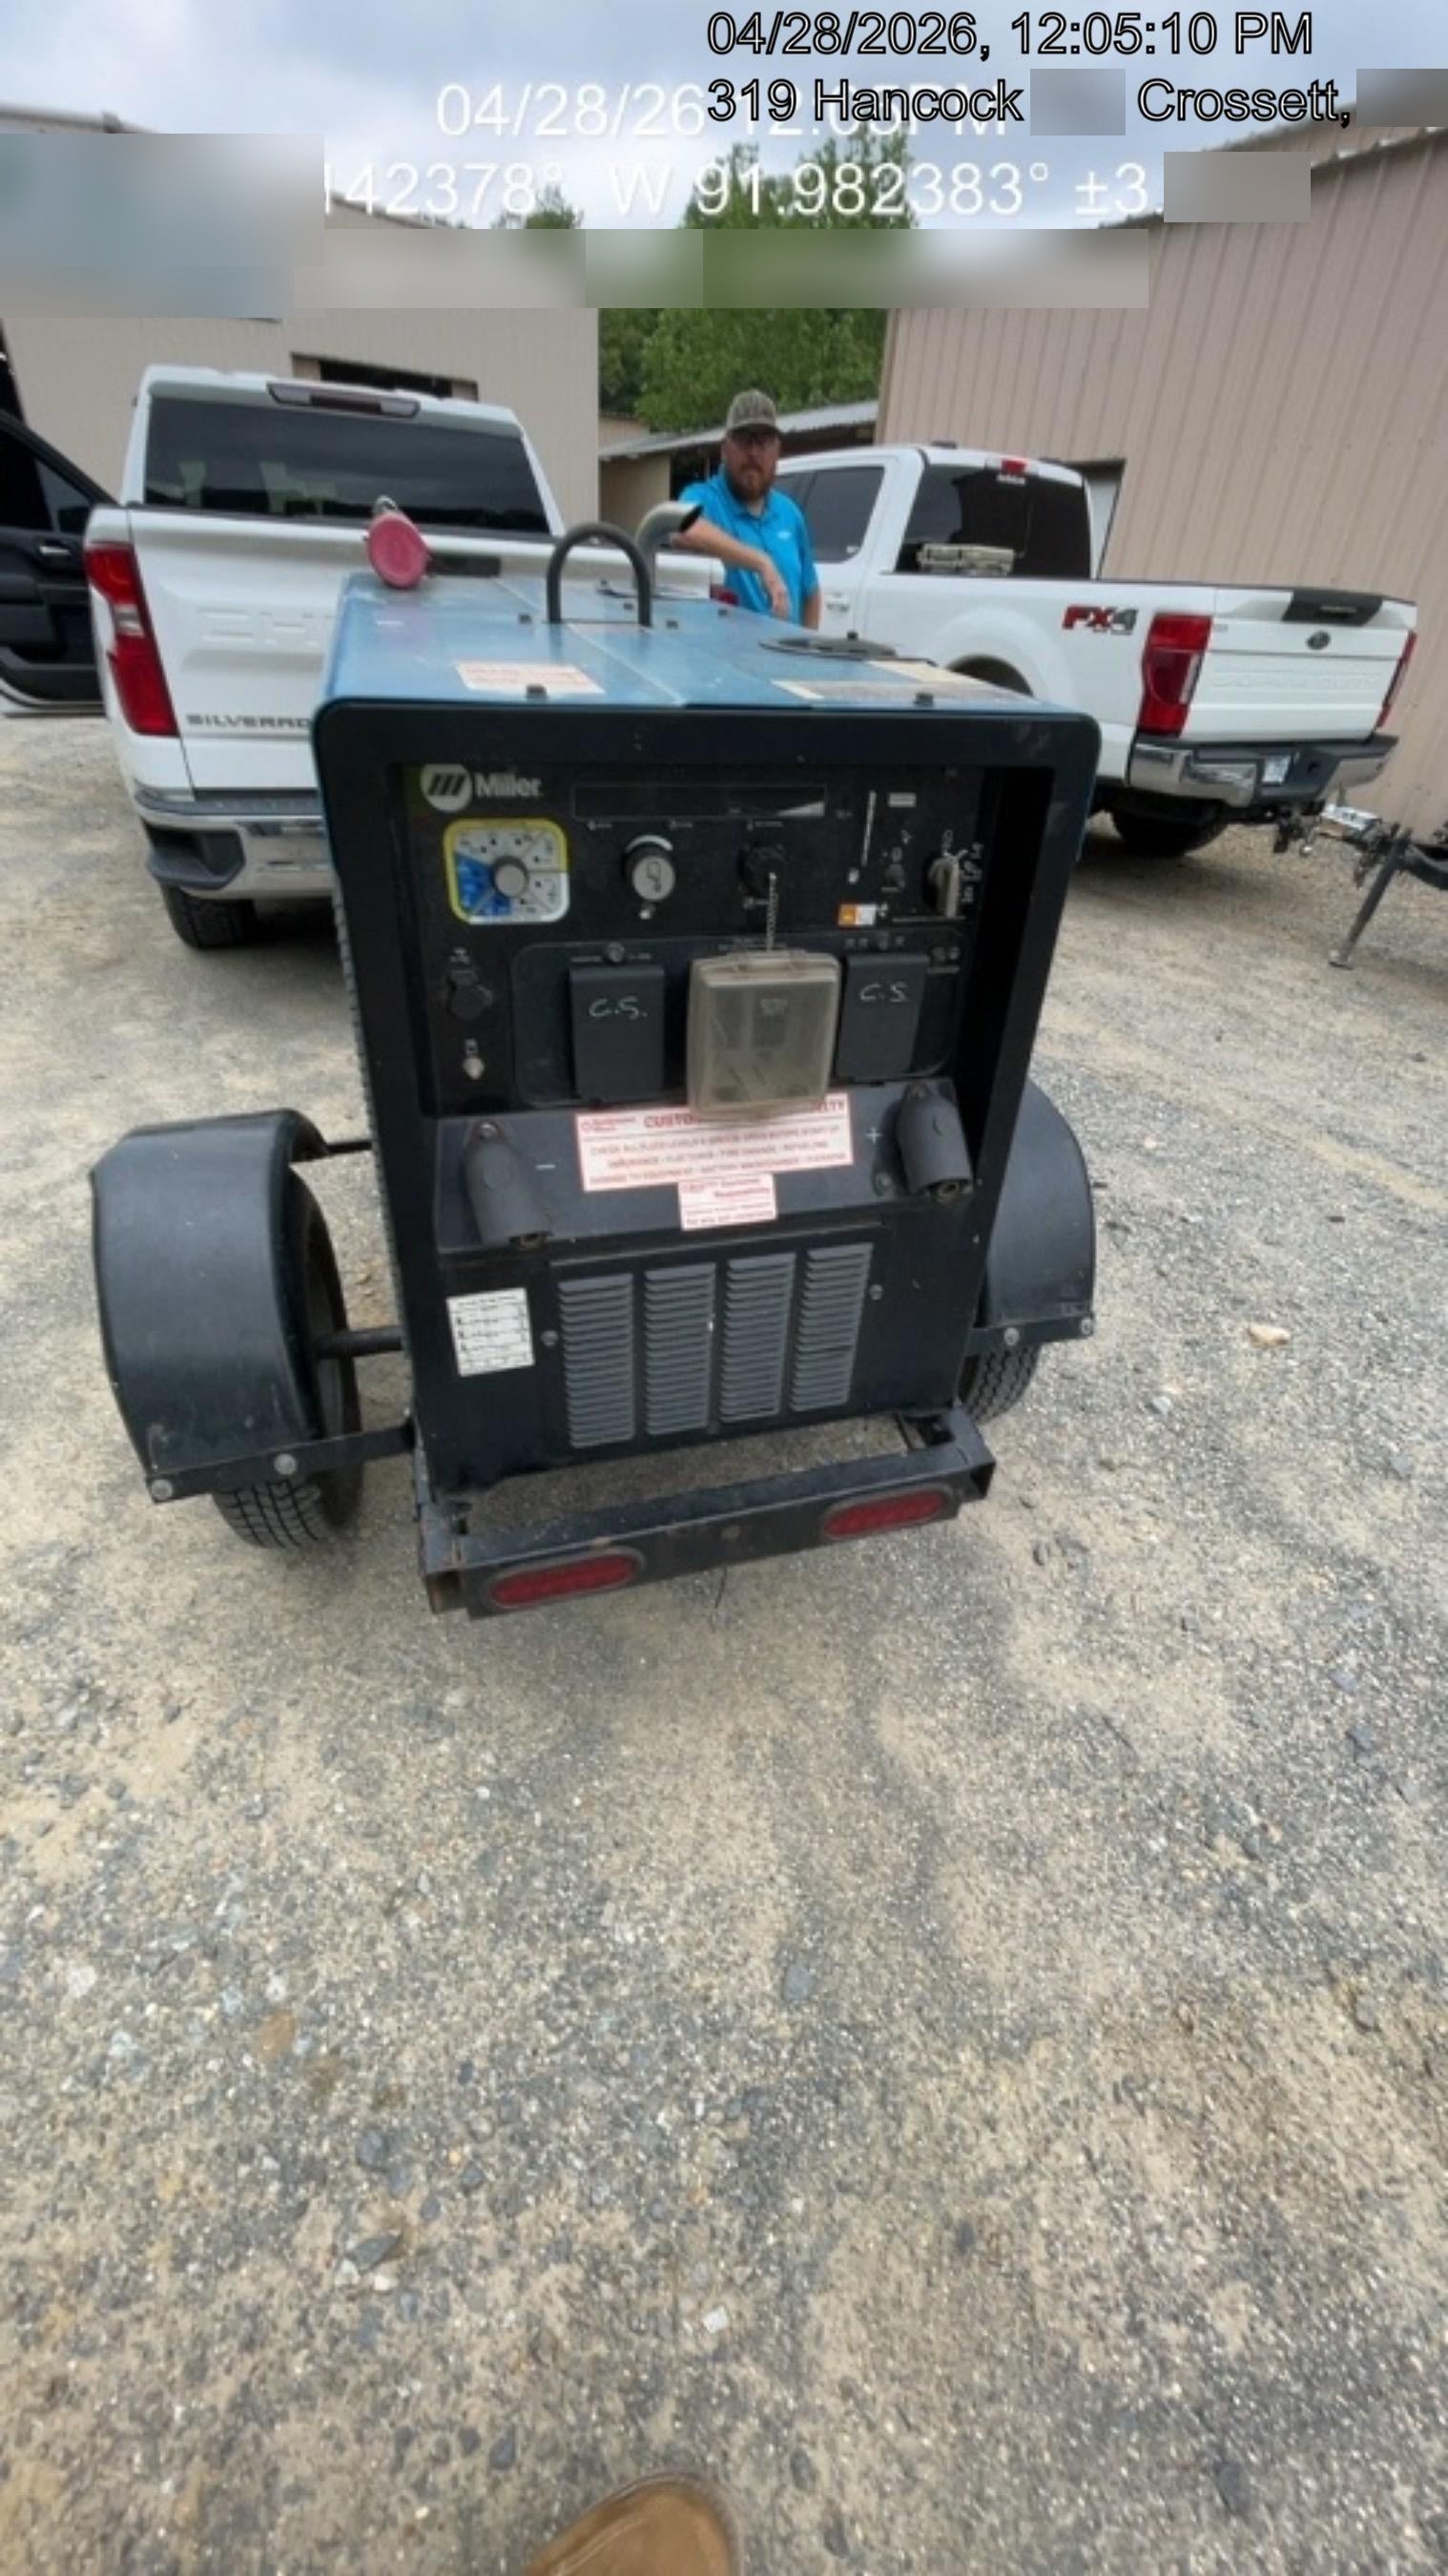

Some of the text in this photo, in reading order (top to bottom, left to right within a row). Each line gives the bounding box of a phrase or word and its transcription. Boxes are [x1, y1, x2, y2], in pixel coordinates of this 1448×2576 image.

[1062, 605, 1139, 635] FX4
[185, 714, 312, 729] SILVERAD
[474, 772, 542, 798] Miller
